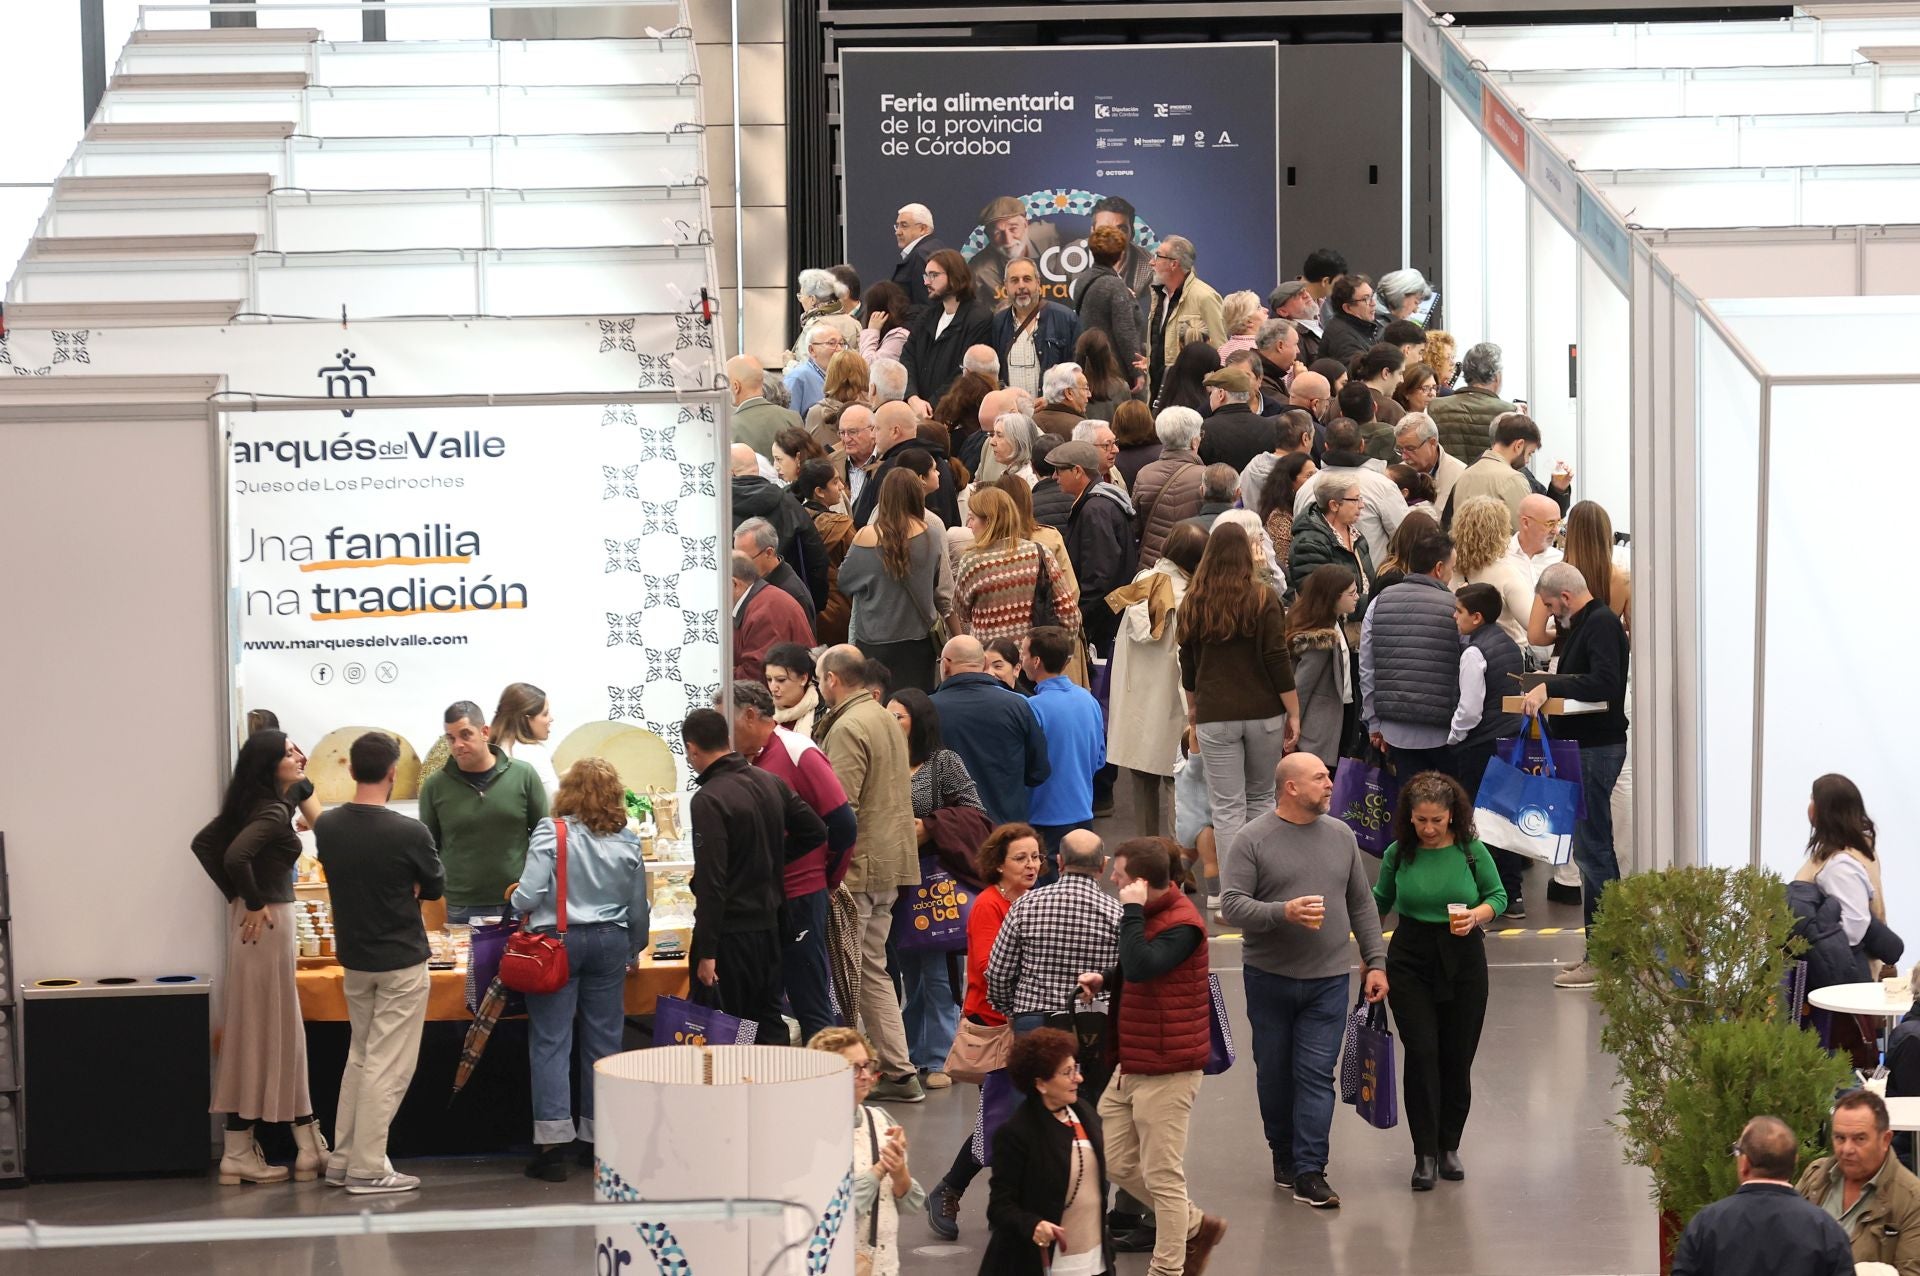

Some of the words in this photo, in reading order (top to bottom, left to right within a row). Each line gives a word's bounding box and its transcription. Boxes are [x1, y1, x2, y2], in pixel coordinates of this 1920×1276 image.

[880, 93, 938, 113] Feria
[943, 91, 1075, 112] alimentaria
[880, 116, 909, 134] de
[917, 116, 936, 134] la
[943, 114, 1042, 136] provincia
[880, 137, 909, 156] de
[914, 135, 1011, 156] Córdoba
[234, 431, 377, 468] arqués
[325, 523, 481, 560] familia
[246, 588, 300, 617] na
[312, 574, 528, 614] tradición
[243, 634, 468, 652] www.marquesdelvalle.com
